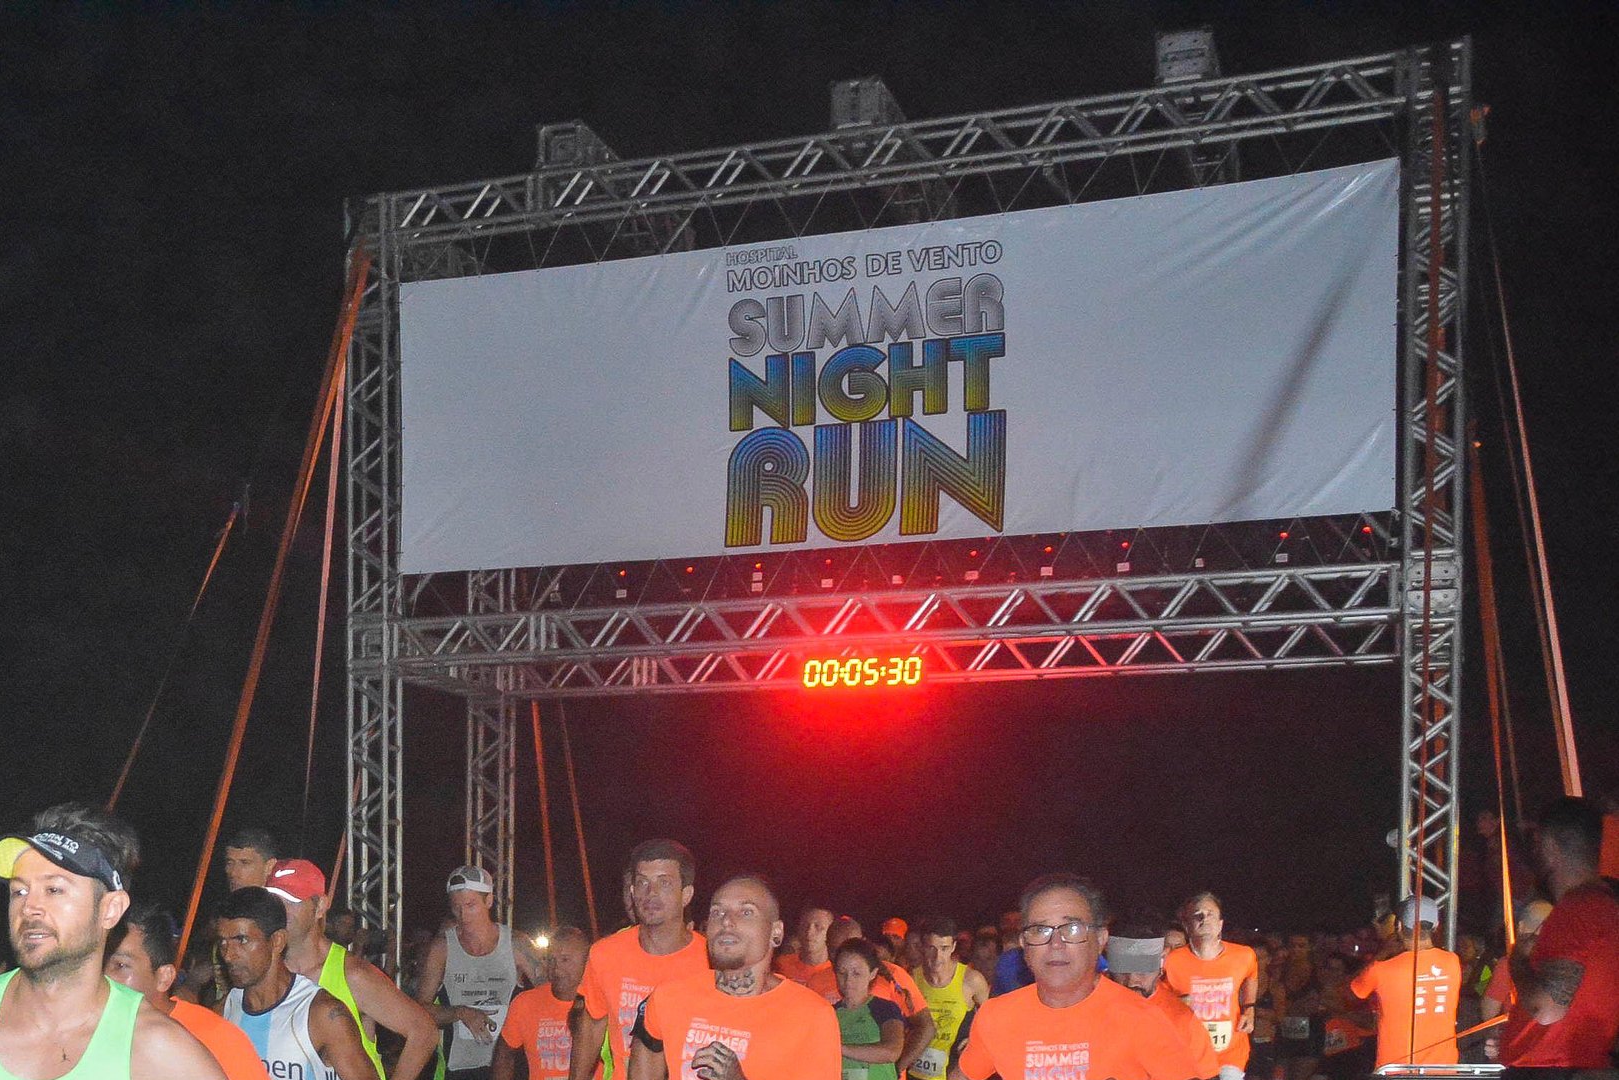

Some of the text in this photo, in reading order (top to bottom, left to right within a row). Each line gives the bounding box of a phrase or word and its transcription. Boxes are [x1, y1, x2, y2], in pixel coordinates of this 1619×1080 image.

[726, 245, 798, 266] HOSPITAL
[727, 240, 1003, 292] MOINHOS DE VENTO
[728, 273, 1005, 357] SUMMER
[729, 333, 1006, 432] NIGHT
[724, 409, 1006, 548] RUN
[803, 656, 922, 688] 00:05:30
[1026, 1050, 1089, 1068] SUMMER
[1212, 1034, 1226, 1045] 11
